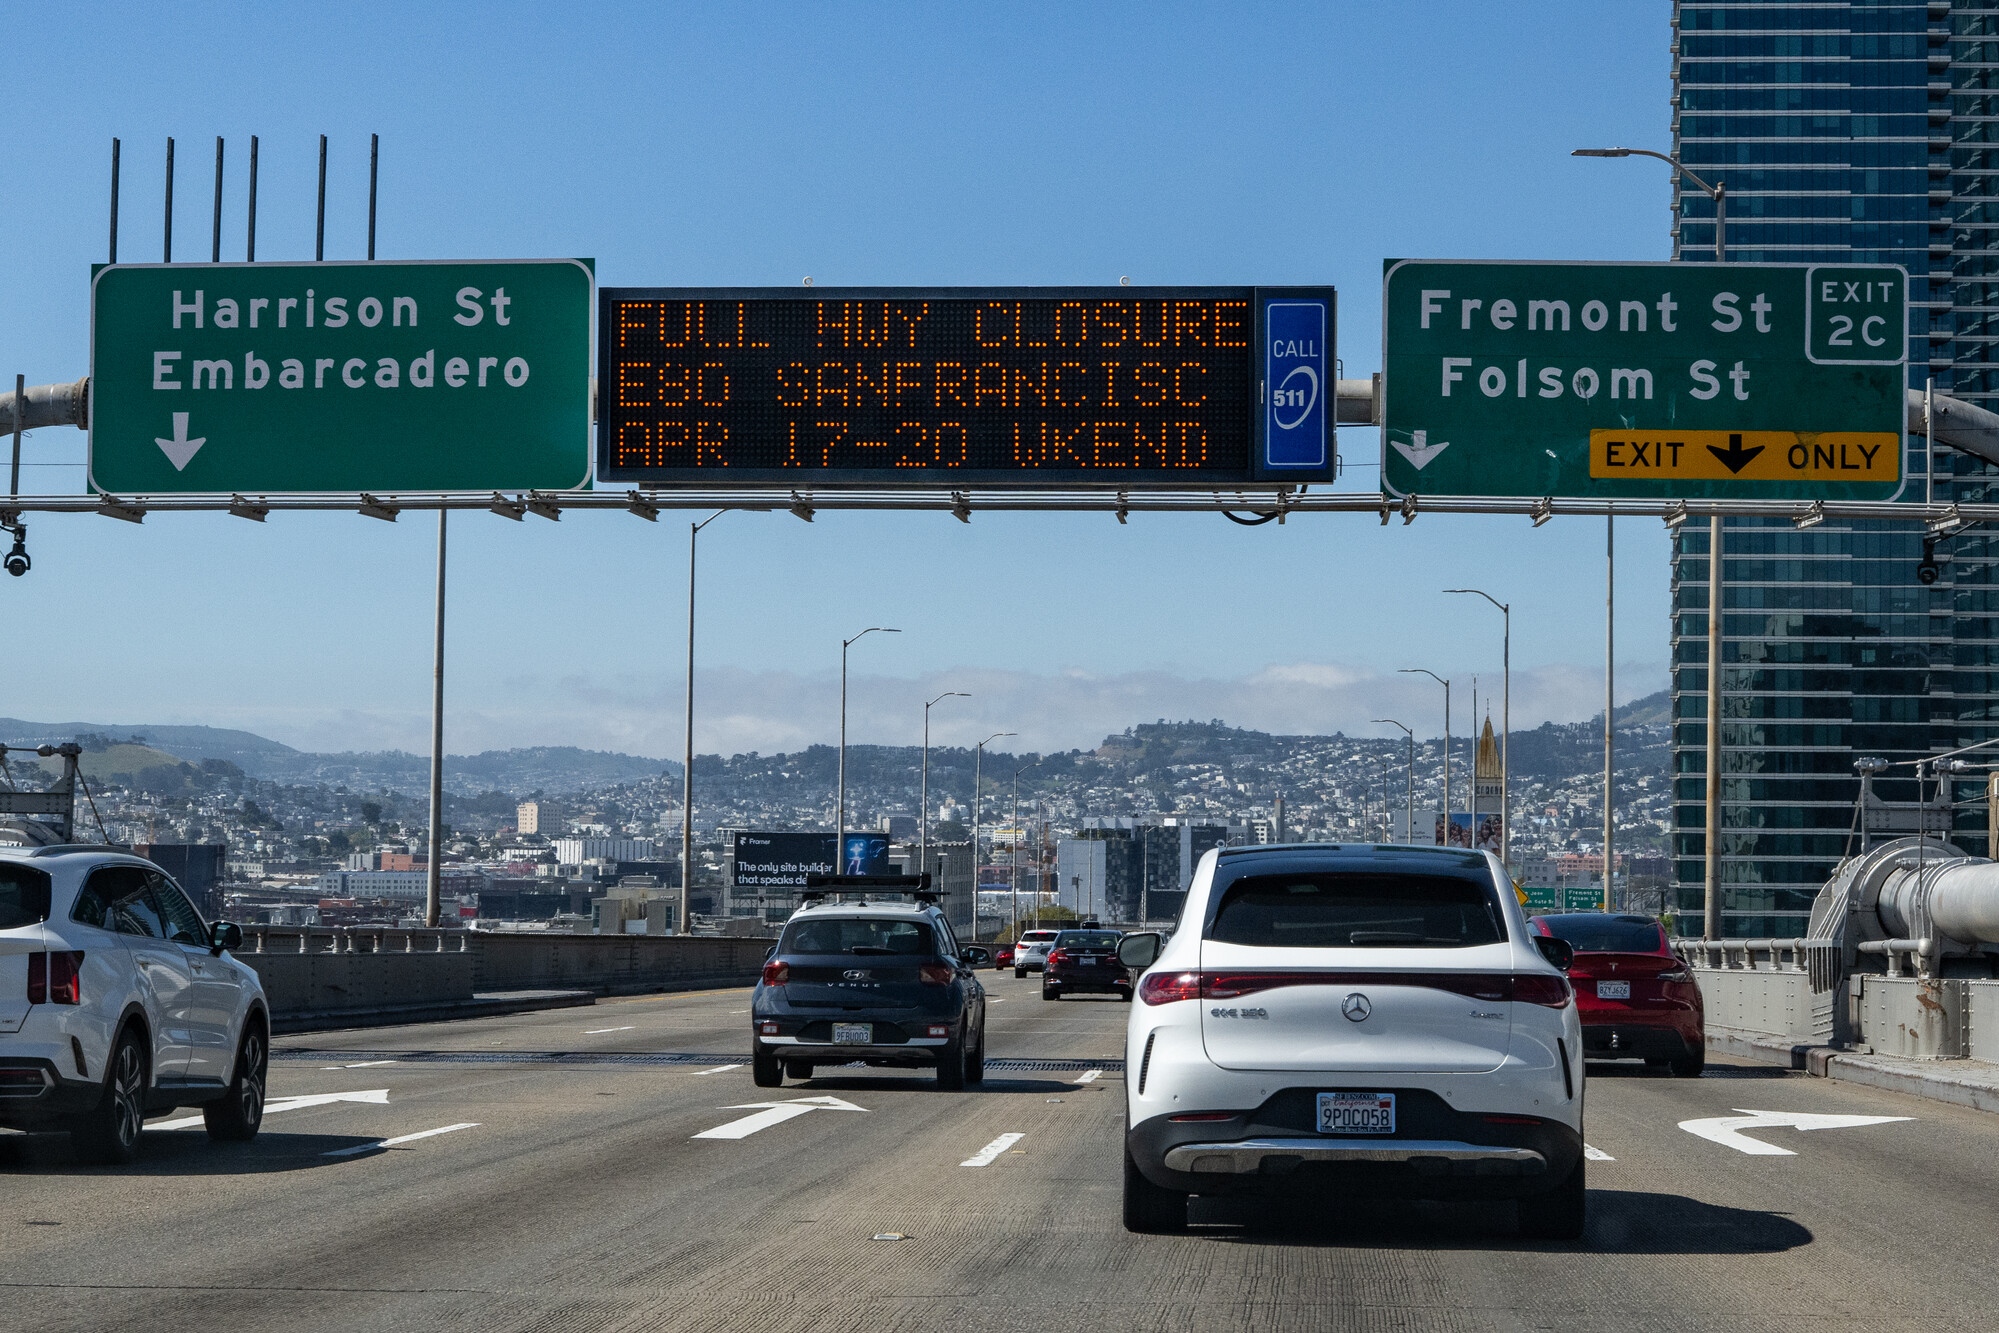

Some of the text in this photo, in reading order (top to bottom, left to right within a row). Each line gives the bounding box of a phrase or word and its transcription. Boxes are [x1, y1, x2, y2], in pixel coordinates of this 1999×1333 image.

[173, 287, 511, 329] Harrison St
[1822, 281, 1894, 303] EXIT
[619, 301, 1247, 348] FULL HWY CLOSURE
[1422, 289, 1772, 333] Fremont St
[1828, 315, 1886, 347] 2C
[1273, 339, 1318, 358] CALL
[153, 349, 530, 390] Embarcadero
[619, 361, 1207, 408] E80 SANFRANCISC
[1441, 357, 1750, 401] Folsom St
[1273, 389, 1304, 407] 511
[618, 421, 1207, 468] APR 17-20 WKEND
[1606, 441, 1881, 470] EXIT ONLY
[738, 861, 833, 874] The only site builder
[738, 874, 759, 884] that
[760, 875, 794, 886] speaks
[1333, 1100, 1379, 1109] California
